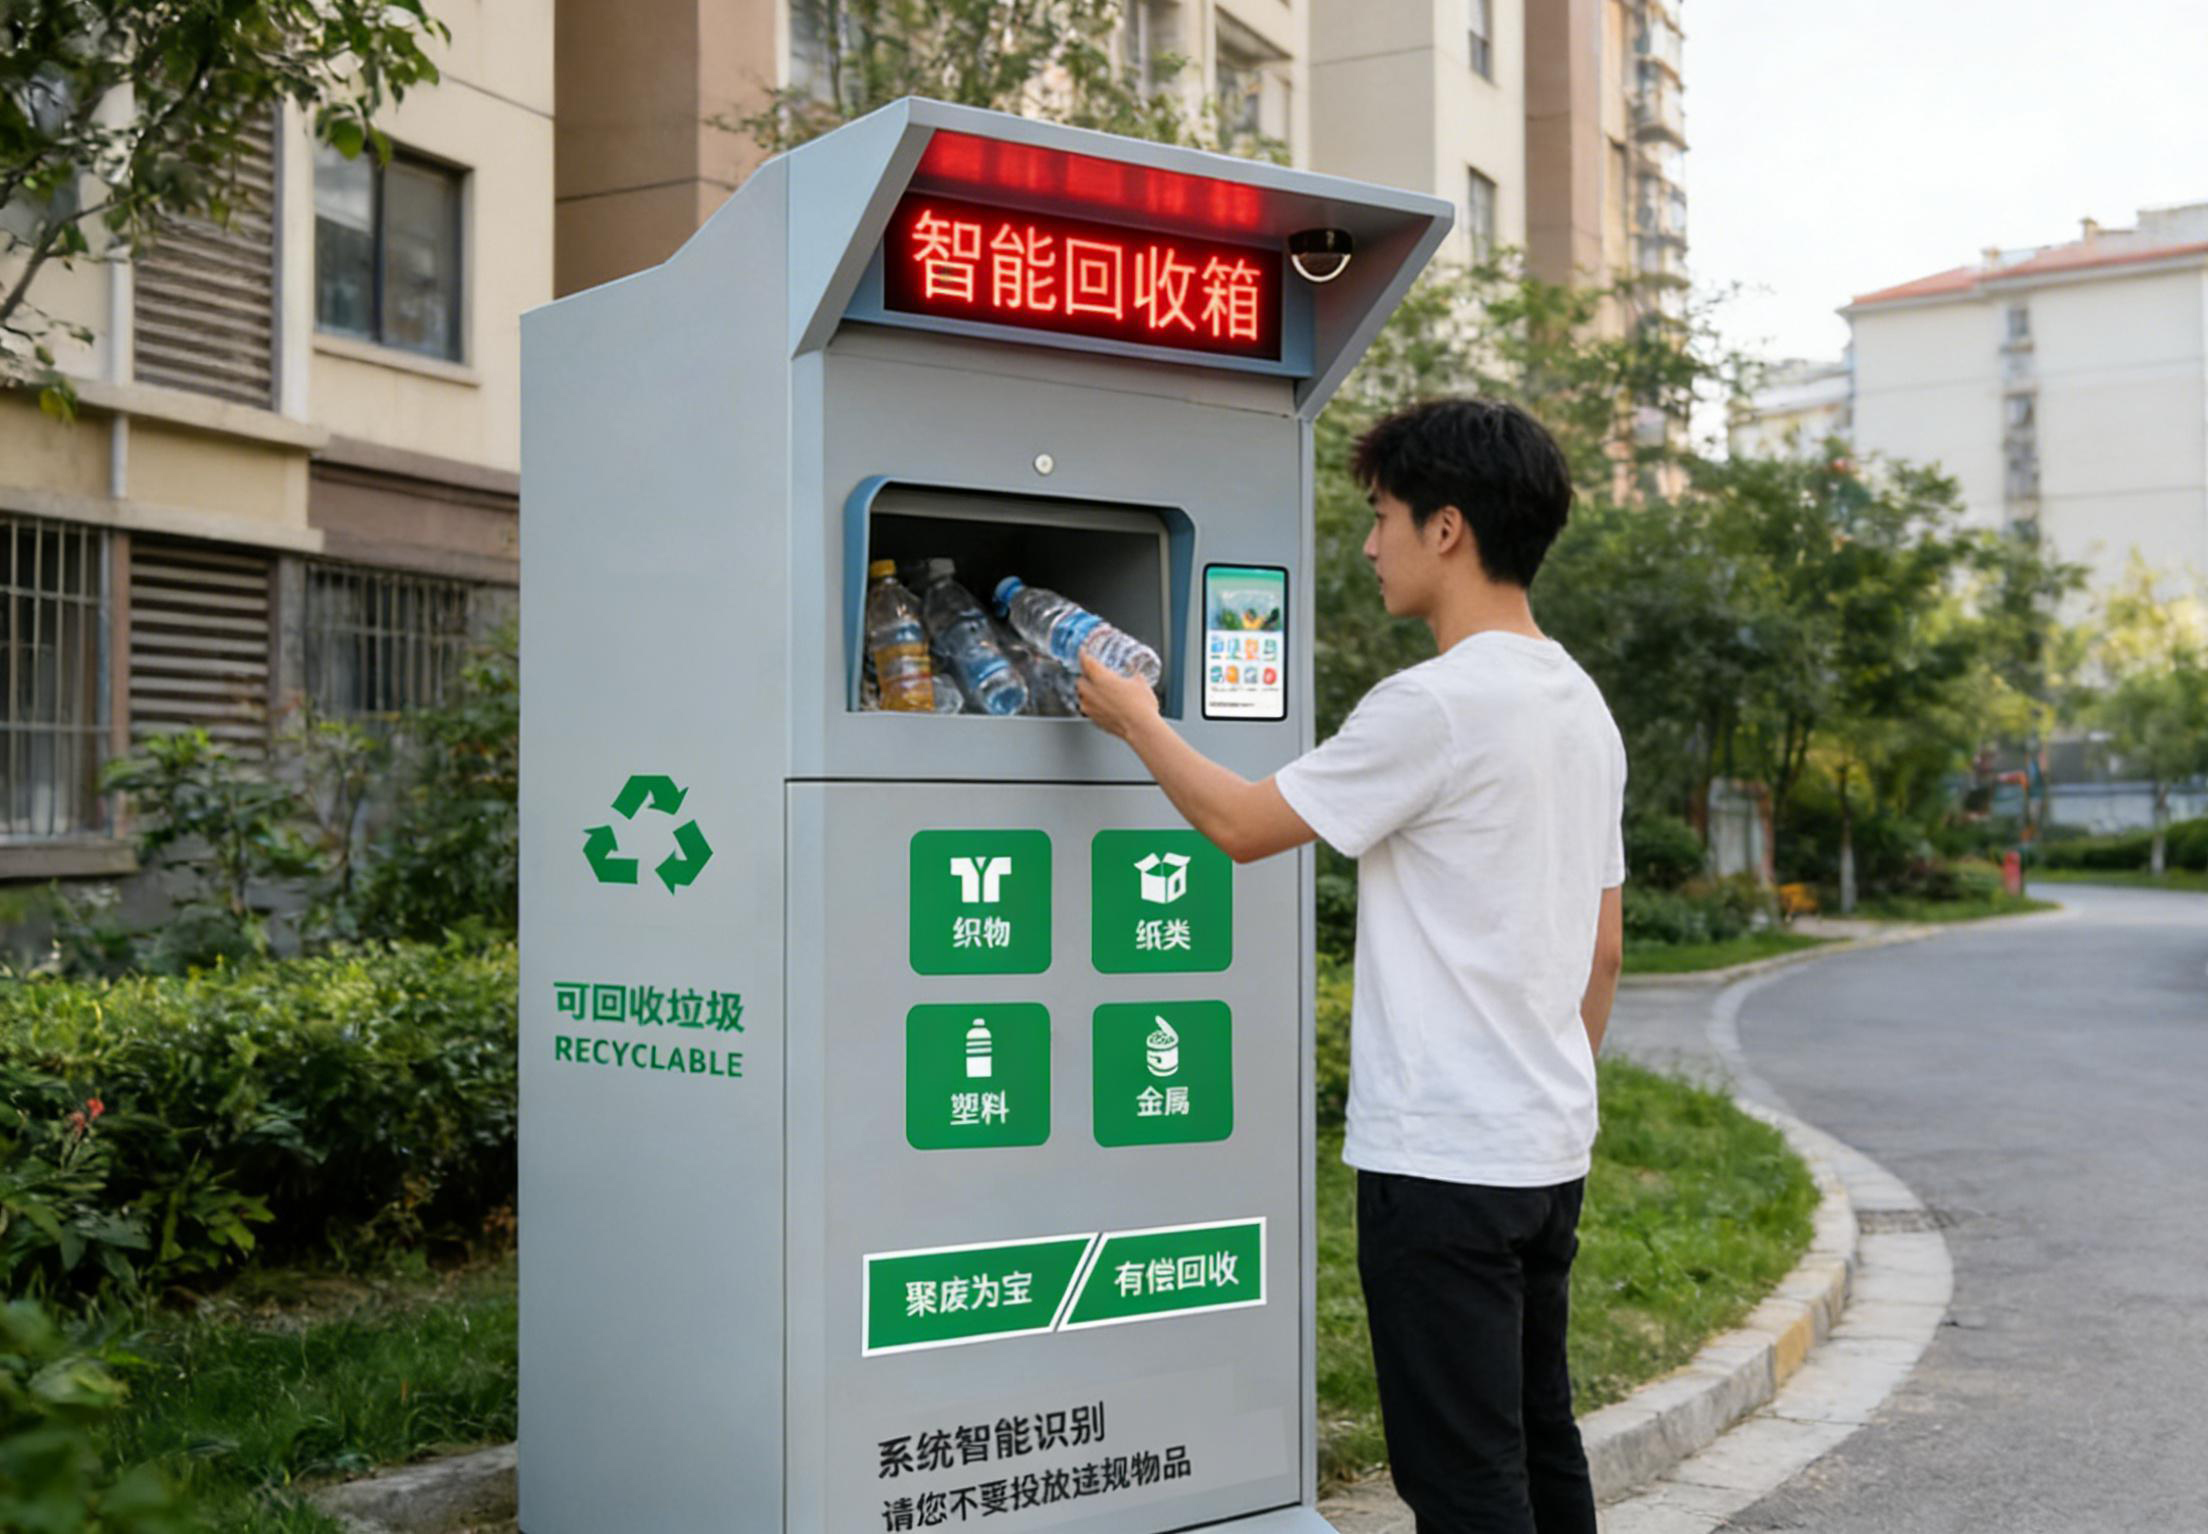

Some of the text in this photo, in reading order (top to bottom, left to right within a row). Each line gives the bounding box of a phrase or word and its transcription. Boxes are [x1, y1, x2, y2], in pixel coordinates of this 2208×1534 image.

[912, 209, 1261, 341] 智能回收箱
[952, 916, 1011, 948] 织物
[1136, 918, 1191, 951] 纸类
[553, 981, 745, 1033] 可回收垃圾
[554, 1035, 743, 1078] RECYCLABLE
[950, 1090, 1010, 1126] 塑料
[905, 1250, 1239, 1318] 聚废为宝 有偿回收
[877, 1400, 1105, 1480] 系统智能识别
